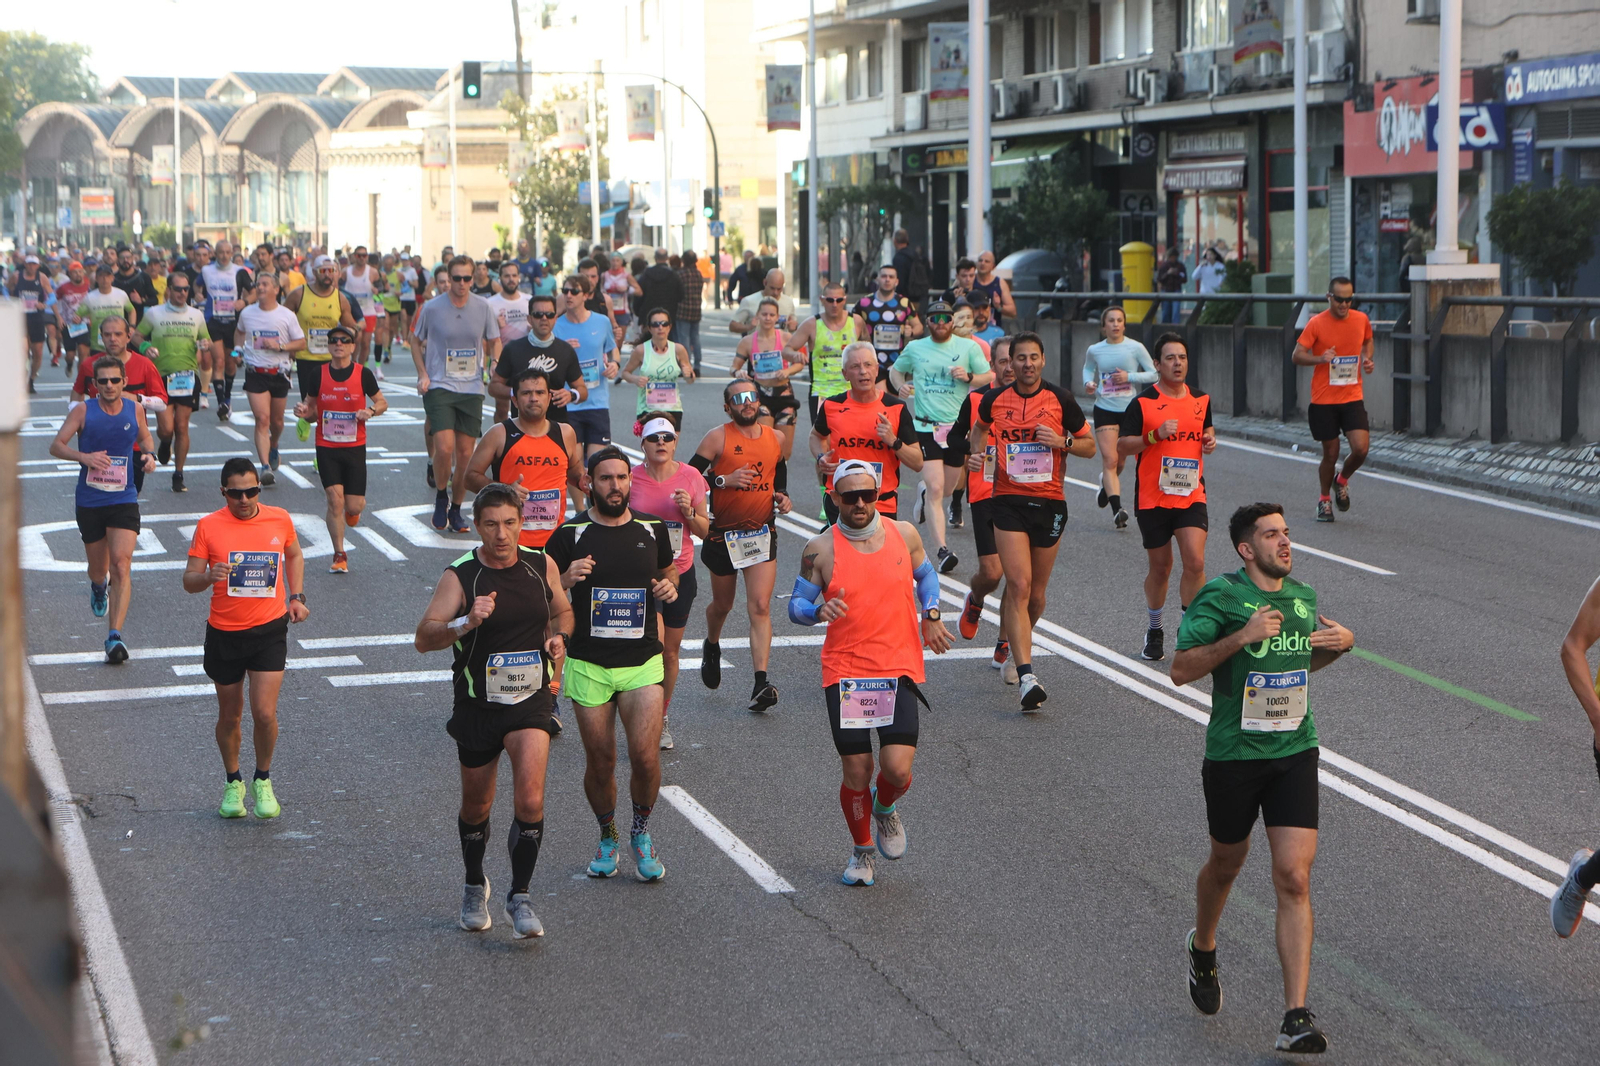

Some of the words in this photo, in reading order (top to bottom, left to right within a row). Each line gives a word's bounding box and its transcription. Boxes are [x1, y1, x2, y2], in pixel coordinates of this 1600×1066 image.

[1526, 65, 1577, 93] AUTOCLIMA
[515, 456, 559, 466] ASFAS
[741, 528, 763, 538] ZURICH
[609, 608, 630, 617] 11658
[508, 655, 534, 664] ZURICH
[1270, 676, 1300, 686] ZURICH
[1266, 697, 1289, 706] 10020
